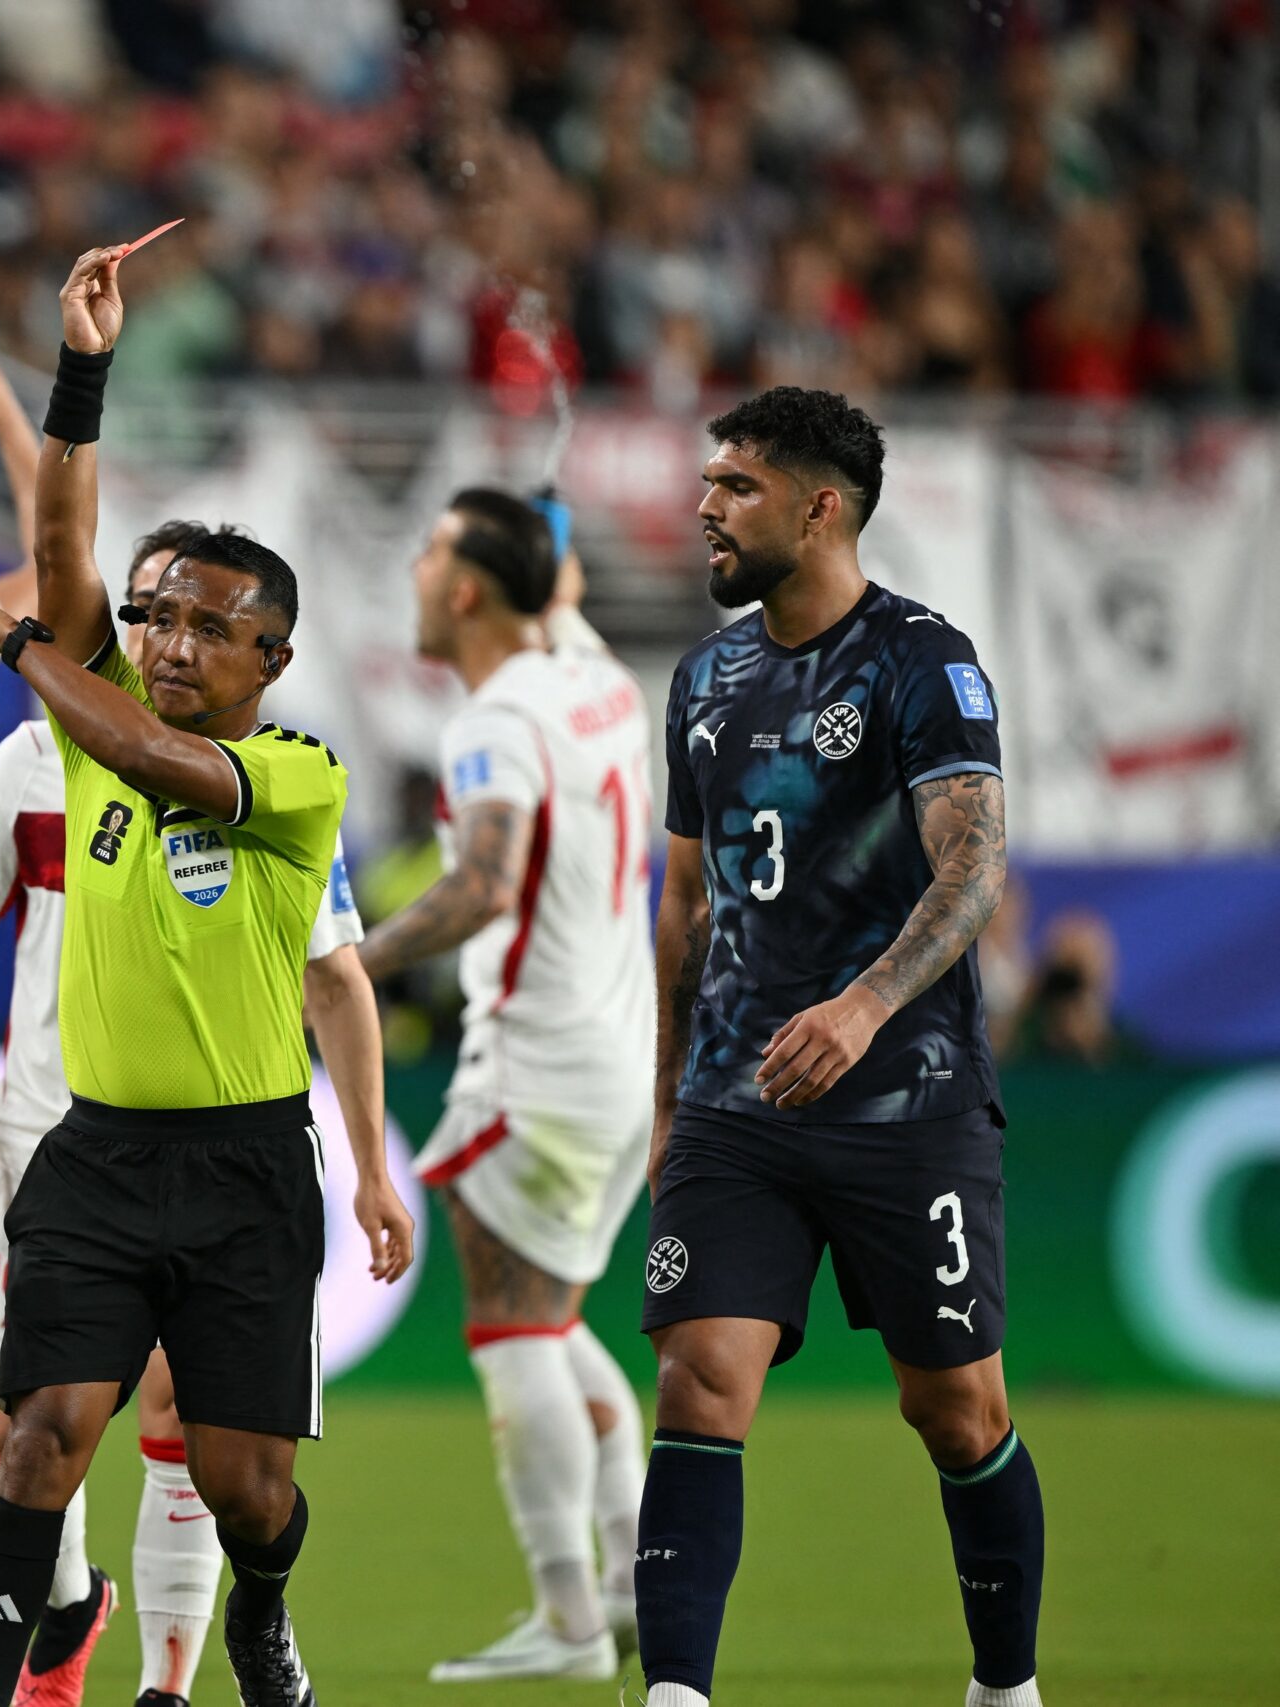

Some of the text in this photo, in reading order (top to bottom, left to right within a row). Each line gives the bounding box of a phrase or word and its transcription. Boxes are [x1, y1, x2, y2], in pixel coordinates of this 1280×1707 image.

[833, 707, 850, 717] APF
[823, 747, 848, 756] PARAGUAY
[168, 829, 224, 856] FIFA
[96, 848, 111, 860] FIFA
[750, 809, 785, 901] 3
[174, 860, 228, 879] REFEREE
[193, 888, 219, 902] 2026
[929, 1190, 970, 1286] 3
[658, 1240, 672, 1253] APF
